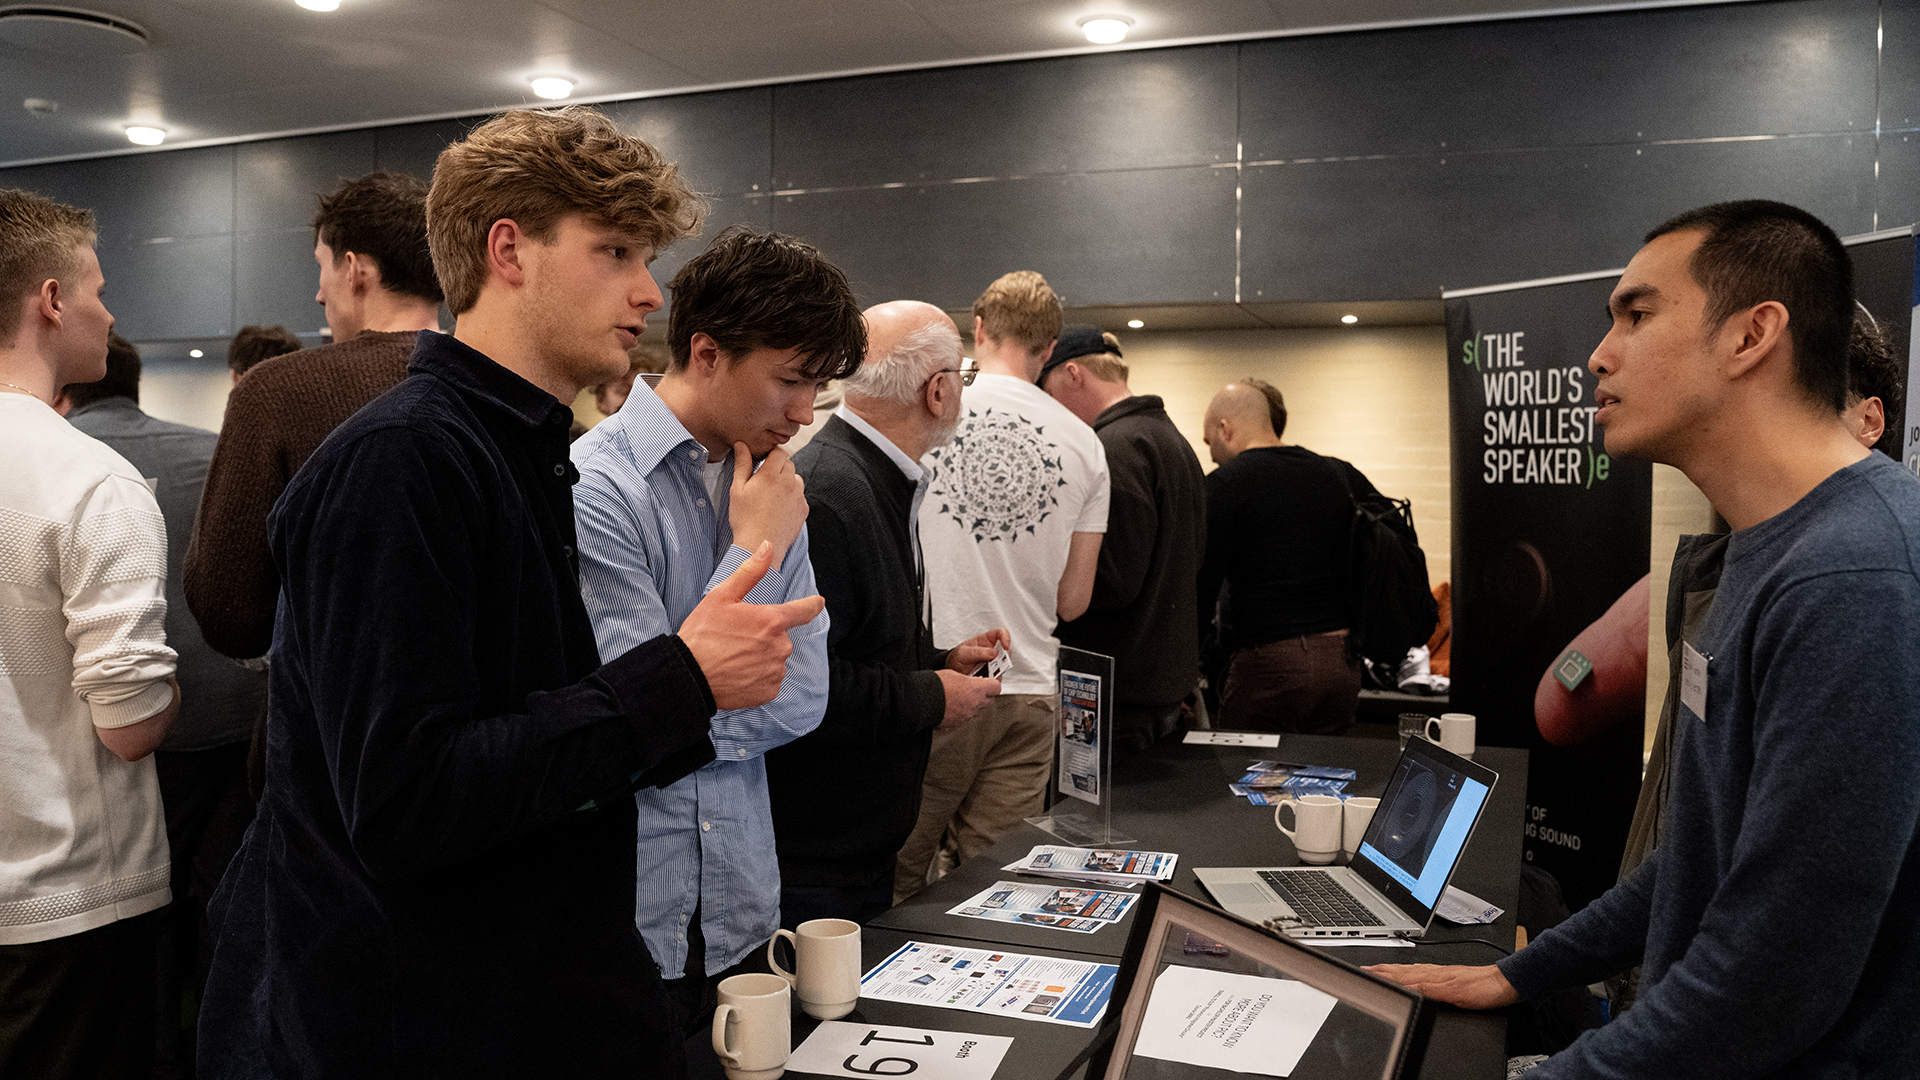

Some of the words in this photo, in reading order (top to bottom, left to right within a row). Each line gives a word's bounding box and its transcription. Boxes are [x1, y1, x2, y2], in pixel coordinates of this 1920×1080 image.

[1483, 332, 1524, 368] THE
[1483, 366, 1583, 407] WORLD'S
[1484, 407, 1599, 446] SMALLEST
[1483, 448, 1582, 484] SPEAKER
[1532, 806, 1547, 821] OF
[1539, 826, 1581, 851] SOUND
[1232, 997, 1252, 1012] MORE
[1251, 1000, 1268, 1011] YOU
[1219, 1011, 1241, 1028] ABOUT
[1240, 1010, 1260, 1026] WANT
[1234, 1024, 1250, 1032] TO
[1222, 1030, 1244, 1049] KNOW
[842, 1030, 936, 1076] 19
[955, 1040, 978, 1059] Booth
